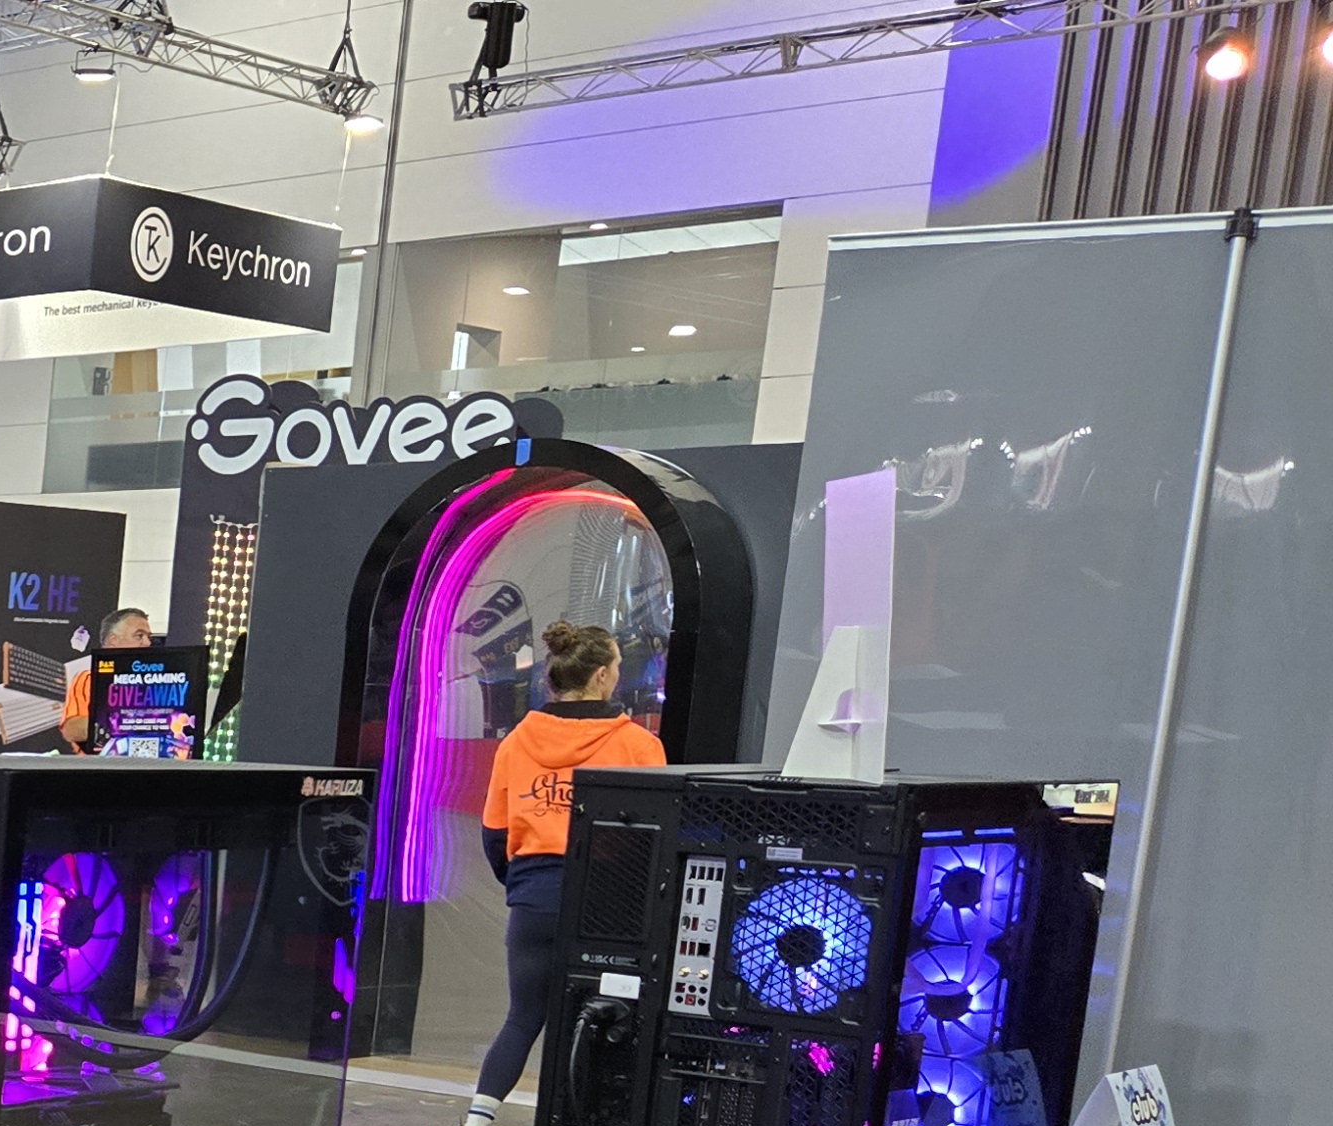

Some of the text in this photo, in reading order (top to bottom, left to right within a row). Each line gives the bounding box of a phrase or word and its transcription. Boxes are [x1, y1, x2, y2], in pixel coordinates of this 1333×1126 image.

[186, 229, 312, 288] Keychron
[43, 305, 60, 317] The
[62, 304, 81, 316] best
[83, 298, 134, 315] mechanical
[191, 379, 516, 476] Govee
[8, 571, 82, 613] K2 HE
[113, 672, 187, 685] MEGA GAMING
[132, 660, 165, 673] Govee
[107, 681, 190, 708] GIVEAWAY
[315, 778, 364, 797] KARUZA
[1131, 1090, 1159, 1123] club
